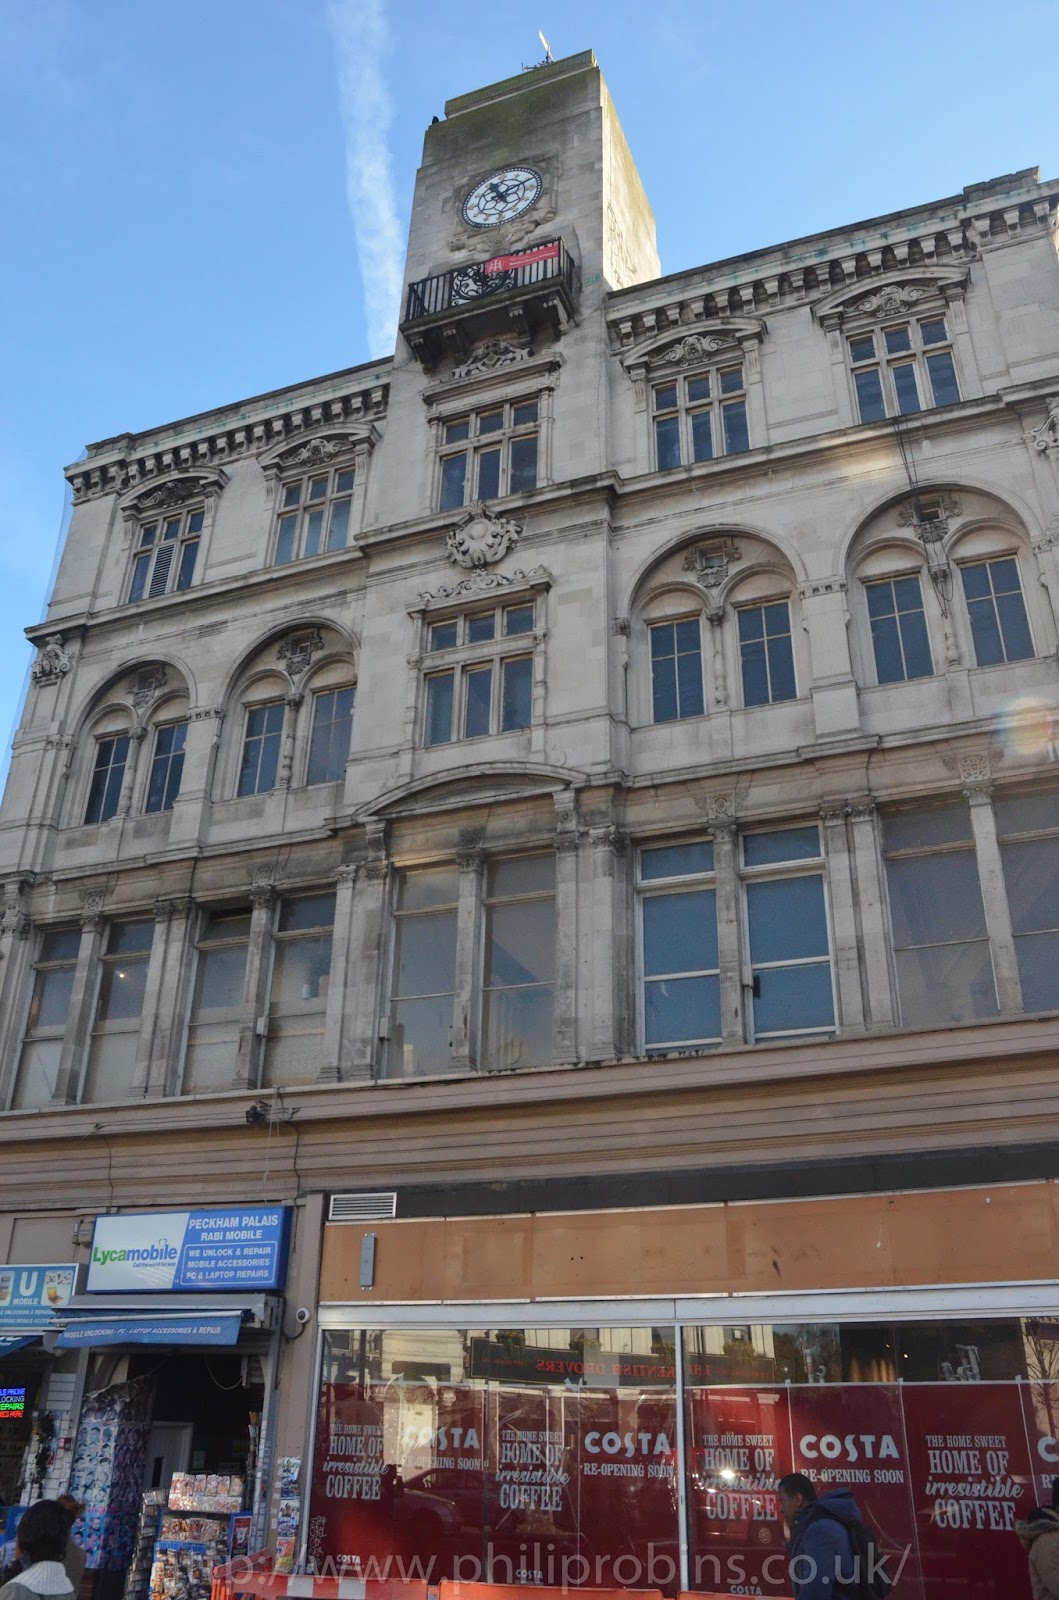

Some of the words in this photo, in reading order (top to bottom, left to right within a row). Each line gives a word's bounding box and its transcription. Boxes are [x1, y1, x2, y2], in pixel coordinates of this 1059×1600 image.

[189, 1216, 239, 1229] PECKHAM
[242, 1214, 279, 1227] PALAIS
[201, 1231, 223, 1241] RABI
[225, 1229, 263, 1240] MOBILE
[92, 1244, 178, 1266] Lycamobile
[189, 1249, 200, 1257] WE
[202, 1248, 233, 1256] UNLOCK
[243, 1247, 271, 1255] REPAIR
[187, 1260, 216, 1268] MOBILE
[217, 1258, 270, 1267] ACCESSORIES
[186, 1271, 197, 1279] PC
[197, 1271, 203, 1279] &
[205, 1270, 235, 1279] LAPTOP
[236, 1269, 269, 1278] REPAIRS
[19, 1271, 39, 1297] U
[12, 1297, 39, 1305] MOBILE
[63, 1330, 84, 1339] MOBILE
[84, 1328, 115, 1337] UNLOCKING
[152, 1326, 193, 1334] ACCESSORIES
[198, 1326, 222, 1334] REPAIR
[330, 1424, 343, 1434] THE
[344, 1424, 362, 1434] HOME
[502, 1430, 516, 1440] THE
[517, 1431, 537, 1441] HOME
[538, 1431, 563, 1442] SWEET
[329, 1435, 365, 1456] HOME
[368, 1437, 384, 1458] OF
[403, 1426, 480, 1451] COSTA
[584, 1431, 672, 1458] COSTA
[703, 1434, 719, 1446] THE
[720, 1434, 744, 1446] HOME
[745, 1434, 774, 1446] SWEET
[925, 1435, 945, 1447] THE
[946, 1435, 973, 1447] HOME
[974, 1435, 1007, 1448] SWEET
[501, 1442, 541, 1464] HOME
[548, 1444, 565, 1466] OF
[799, 1434, 900, 1462] COSTA
[323, 1456, 389, 1475] irresistible
[457, 1457, 482, 1471] SOON
[703, 1448, 750, 1471] HOME
[754, 1448, 775, 1471] OF
[927, 1450, 982, 1474] HOME
[986, 1450, 1009, 1475] OF
[495, 1465, 571, 1485] irresistible
[583, 1462, 645, 1477] RE-OPENING
[647, 1464, 674, 1478] SOON
[874, 1469, 904, 1483] SOON
[325, 1475, 382, 1500] COFFEE
[925, 1475, 1025, 1498] irresistible
[500, 1484, 563, 1512] COFFEE
[706, 1493, 778, 1521] COFFEE
[934, 1498, 1016, 1531] COFFEE
[336, 1554, 361, 1564] COSTA
[515, 1568, 544, 1579] COSTA
[730, 1585, 763, 1596] COSTA
